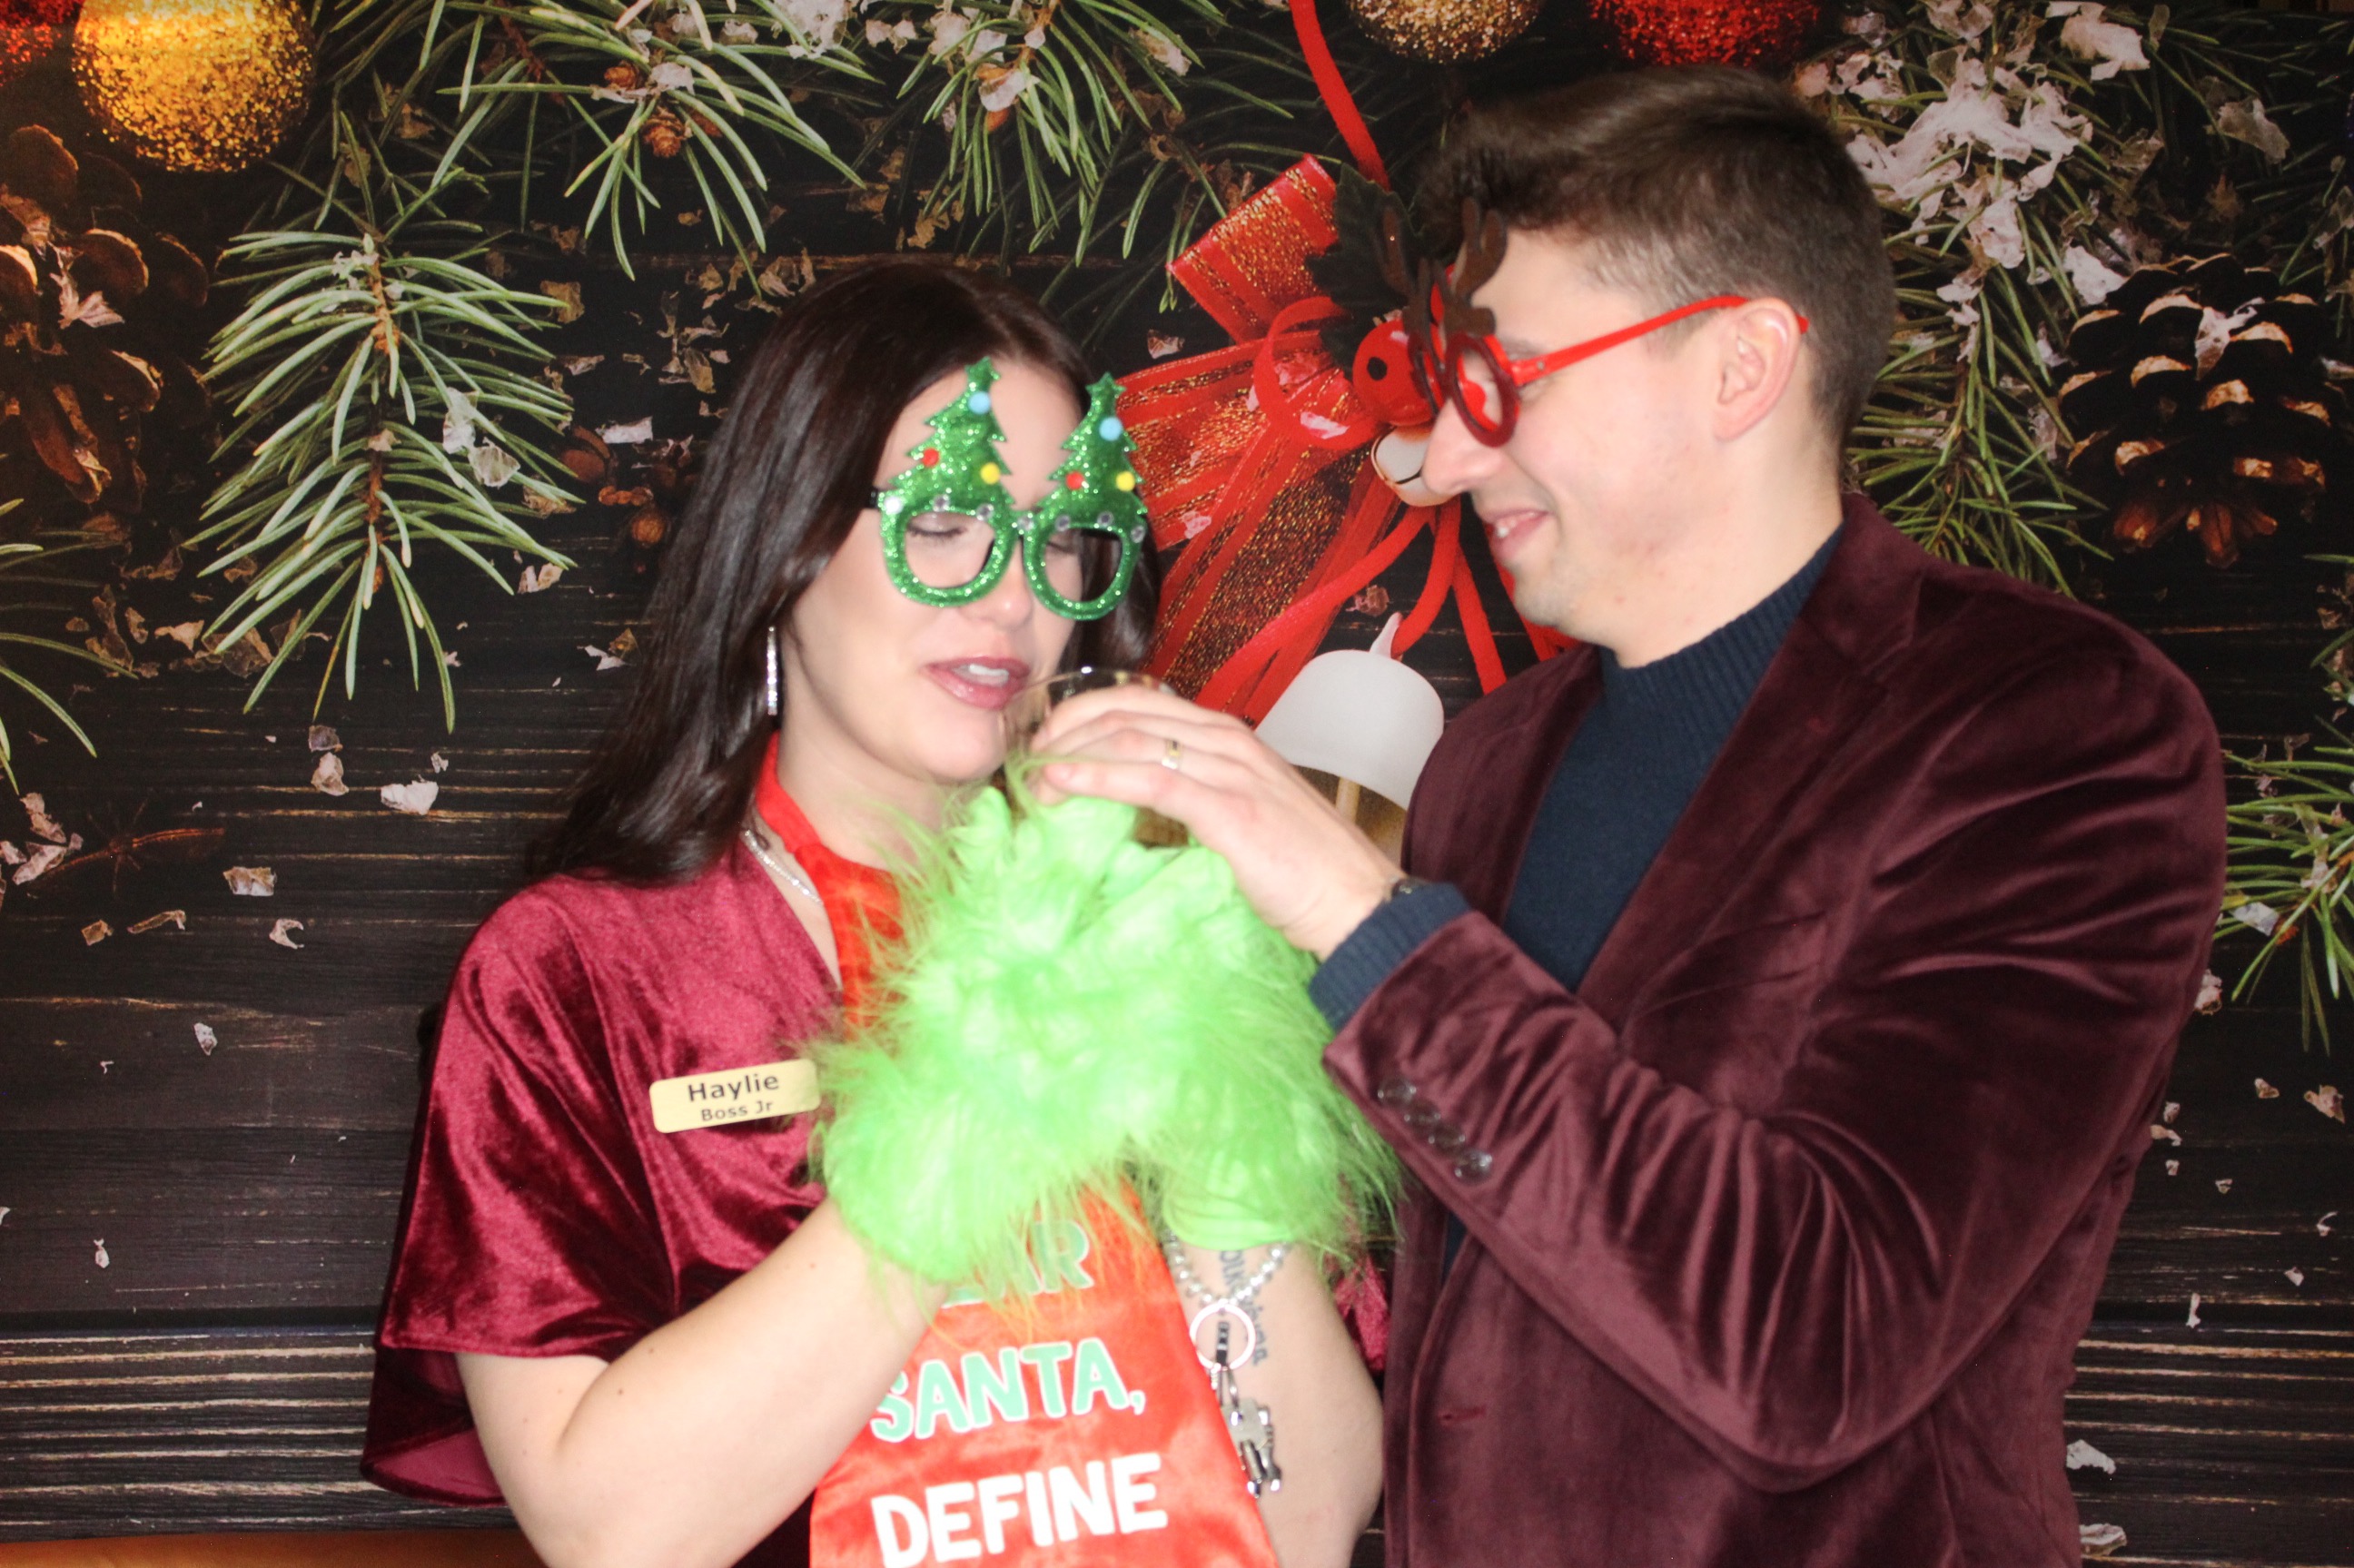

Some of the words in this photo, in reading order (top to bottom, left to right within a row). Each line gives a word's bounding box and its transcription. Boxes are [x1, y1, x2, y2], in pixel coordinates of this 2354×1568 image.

[687, 1074, 779, 1101] Haylie
[701, 1104, 748, 1122] Boss
[756, 1100, 774, 1114] Jr
[870, 1337, 1145, 1443] SANTA,
[870, 1453, 1168, 1568] DEFINE
